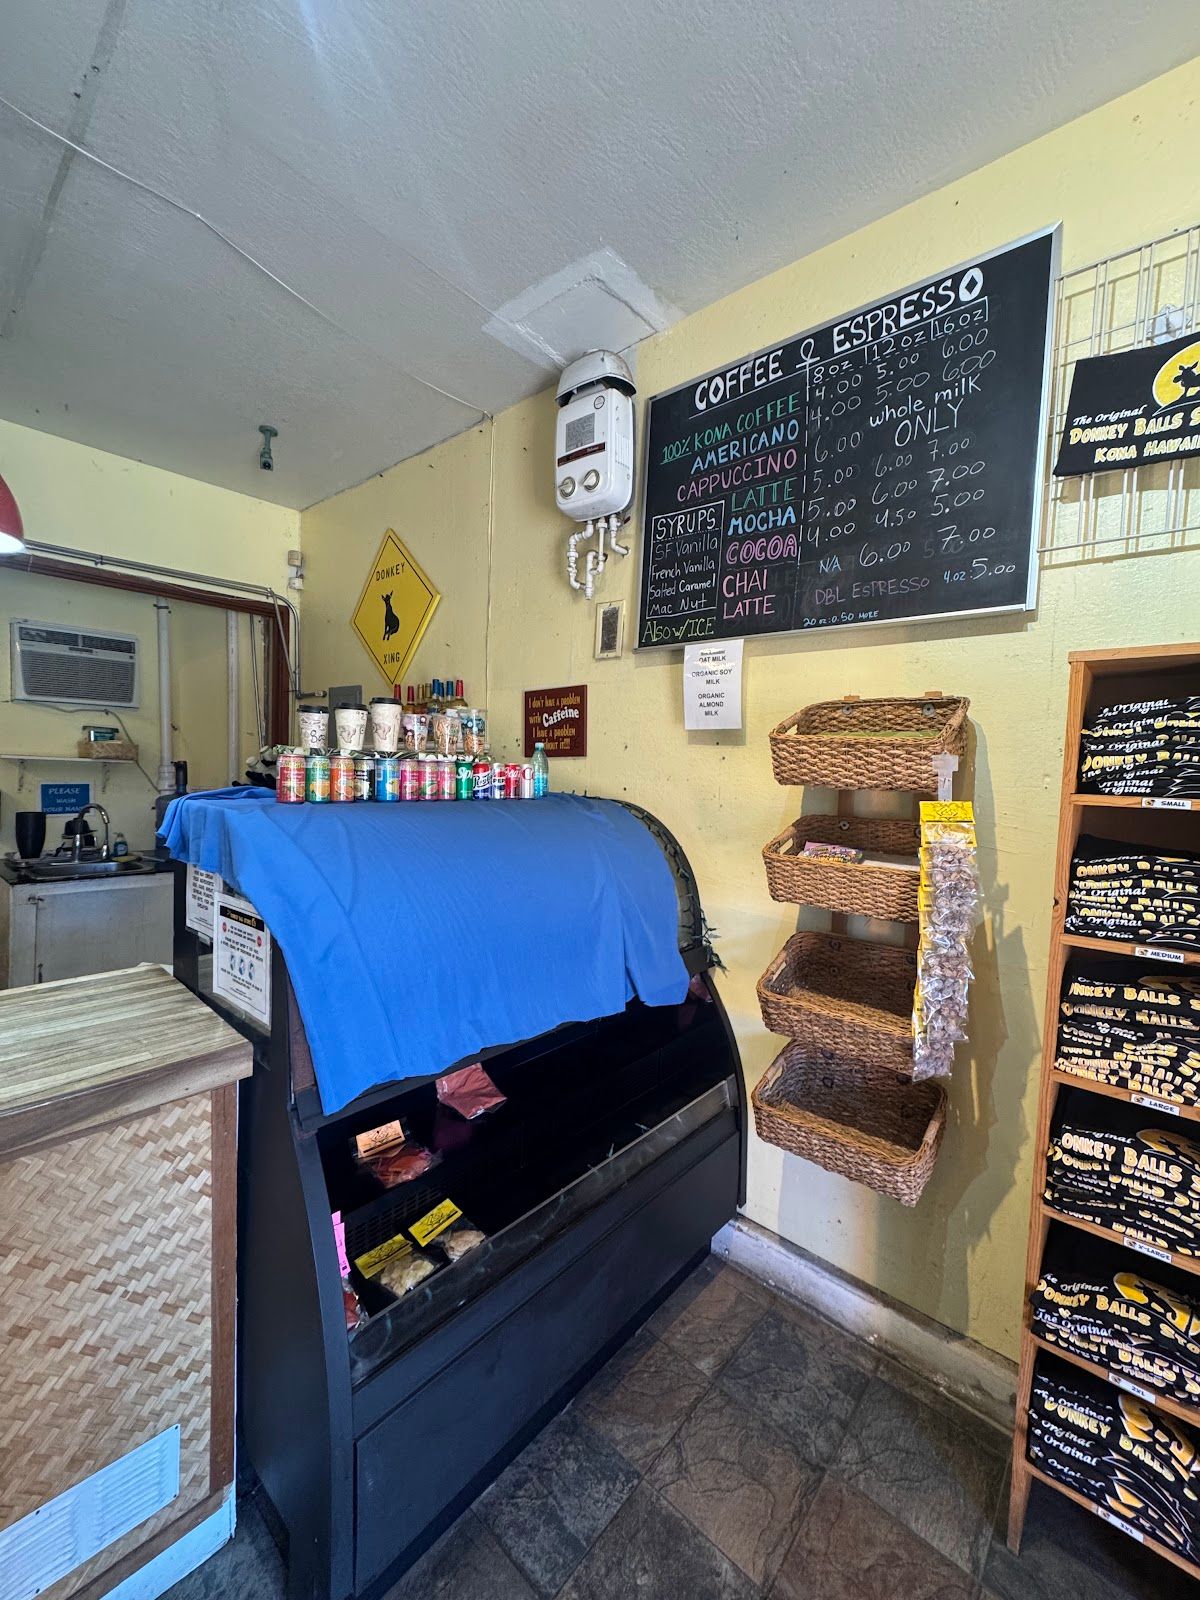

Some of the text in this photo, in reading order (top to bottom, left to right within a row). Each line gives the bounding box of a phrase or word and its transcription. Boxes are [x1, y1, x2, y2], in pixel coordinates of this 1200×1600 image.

[694, 349, 784, 411] COFFEE
[833, 268, 984, 354] ESPRESSO
[661, 328, 989, 465] 100% KONA COFFEE 4.00 5.00 6.00
[691, 419, 799, 474] AMERICANO
[810, 396, 861, 428] 4.00
[875, 372, 930, 405] 5.00
[870, 395, 926, 427] whole
[894, 398, 964, 447] ONLY
[1073, 404, 1148, 426] The Original
[1069, 422, 1128, 445] DONKEY
[1133, 412, 1185, 436] BALLS
[677, 432, 862, 502] CAPPUCCINO 6.00
[1094, 445, 1137, 463] KONA
[732, 438, 970, 512] LATTE 5.00 6.00 7.00
[727, 461, 985, 536] MOCHA 5.00 6.00 7.00
[656, 508, 716, 540] SYRUPS
[726, 489, 985, 565] COCOA 4.00 4.50 5.00
[655, 533, 718, 561] SF Vanilla
[375, 562, 406, 582] DONKEY
[652, 556, 715, 582] French Vanilla
[723, 525, 996, 598] CHAI N/A 6.00 7.00
[650, 573, 716, 600] Salted Caramel
[815, 586, 846, 606] DBL
[650, 593, 707, 616] Mac Nut
[723, 594, 776, 619] LATTE
[803, 617, 817, 627] 20
[383, 652, 400, 665] XING
[691, 668, 733, 677] ORGANIC SOY
[542, 706, 580, 728] Caffeine
[1150, 951, 1182, 961] MEDIUM
[1123, 987, 1181, 1006] BALLS
[1149, 1101, 1174, 1112] LARGE
[1123, 1146, 1182, 1183] BALLS
[1138, 1244, 1171, 1261] X-LARGE
[1096, 1294, 1152, 1326] BALLS
[1131, 1385, 1146, 1397] 2XL
[1044, 1435, 1102, 1467] Original
